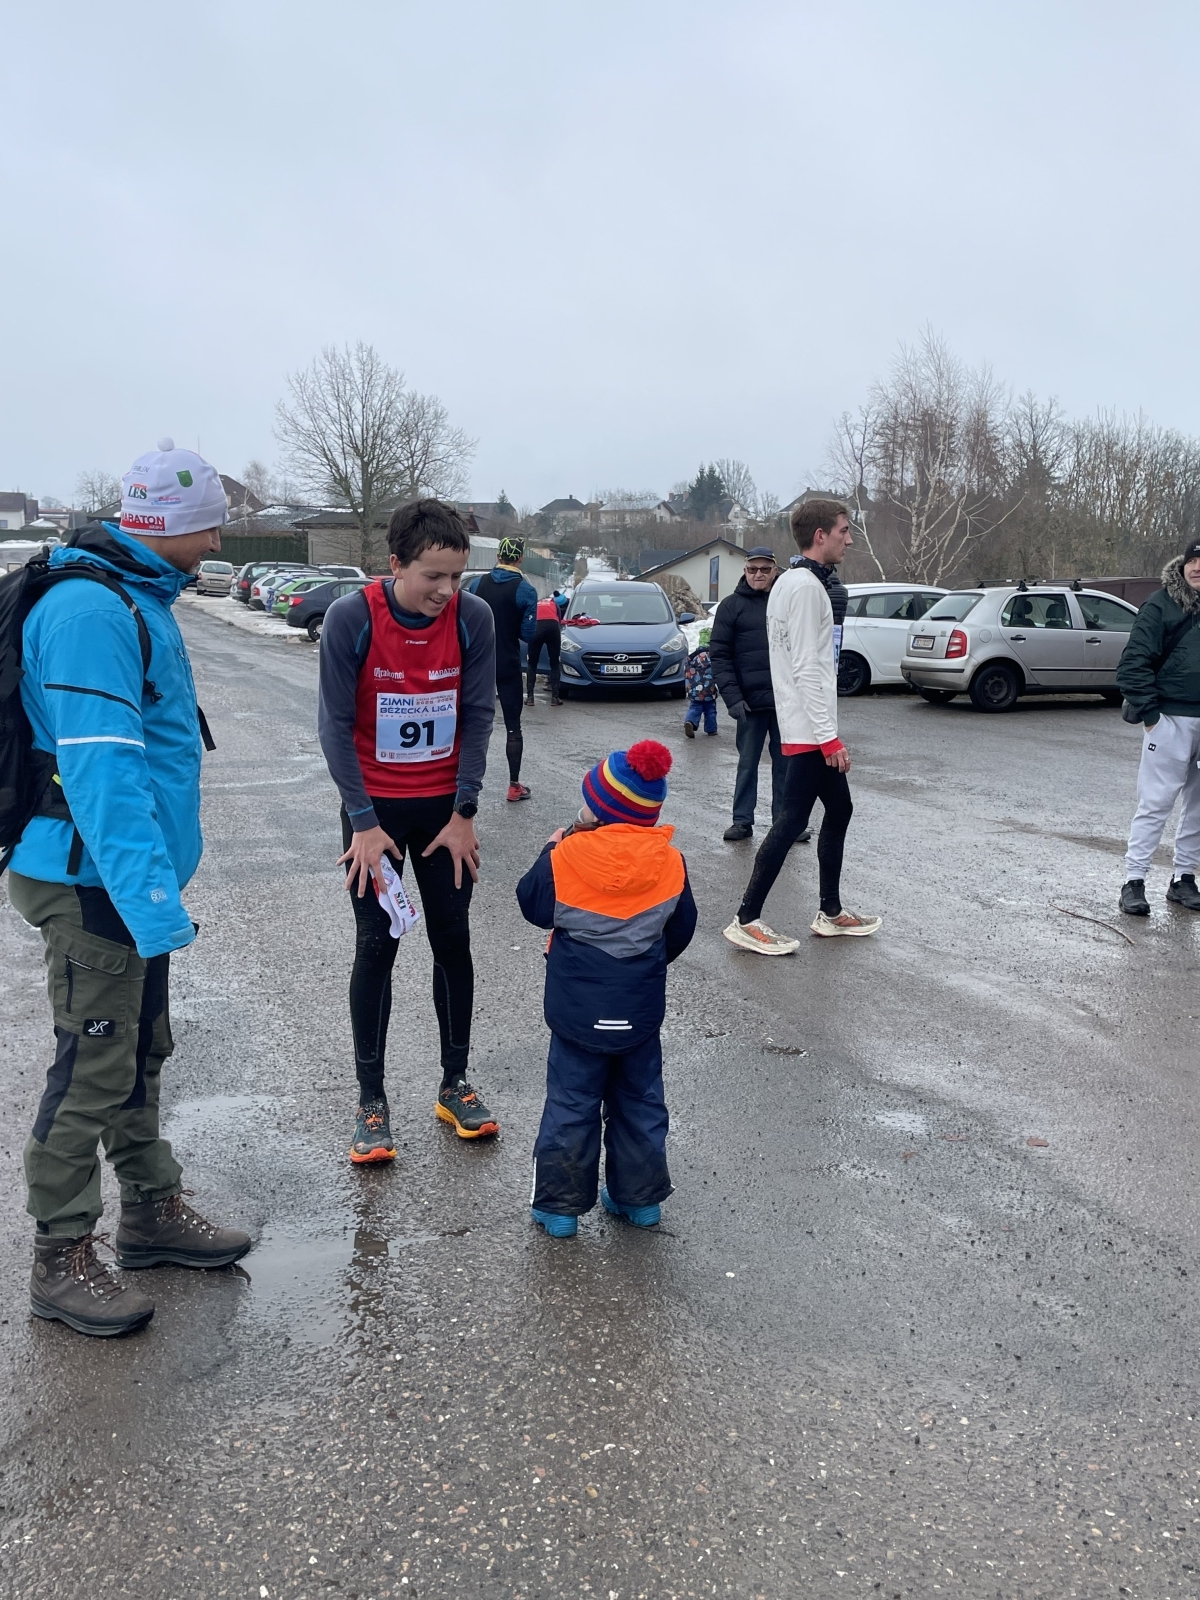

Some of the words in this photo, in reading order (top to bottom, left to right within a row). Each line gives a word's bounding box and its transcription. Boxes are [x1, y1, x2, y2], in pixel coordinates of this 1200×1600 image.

[128, 485, 147, 500] LES
[606, 665, 618, 673] 6H3
[623, 665, 639, 673] 8411
[380, 697, 414, 706] ZIMNÍ
[380, 706, 429, 714] BĚŽECKÁ
[432, 704, 453, 713] LIGA
[400, 720, 434, 748] 91
